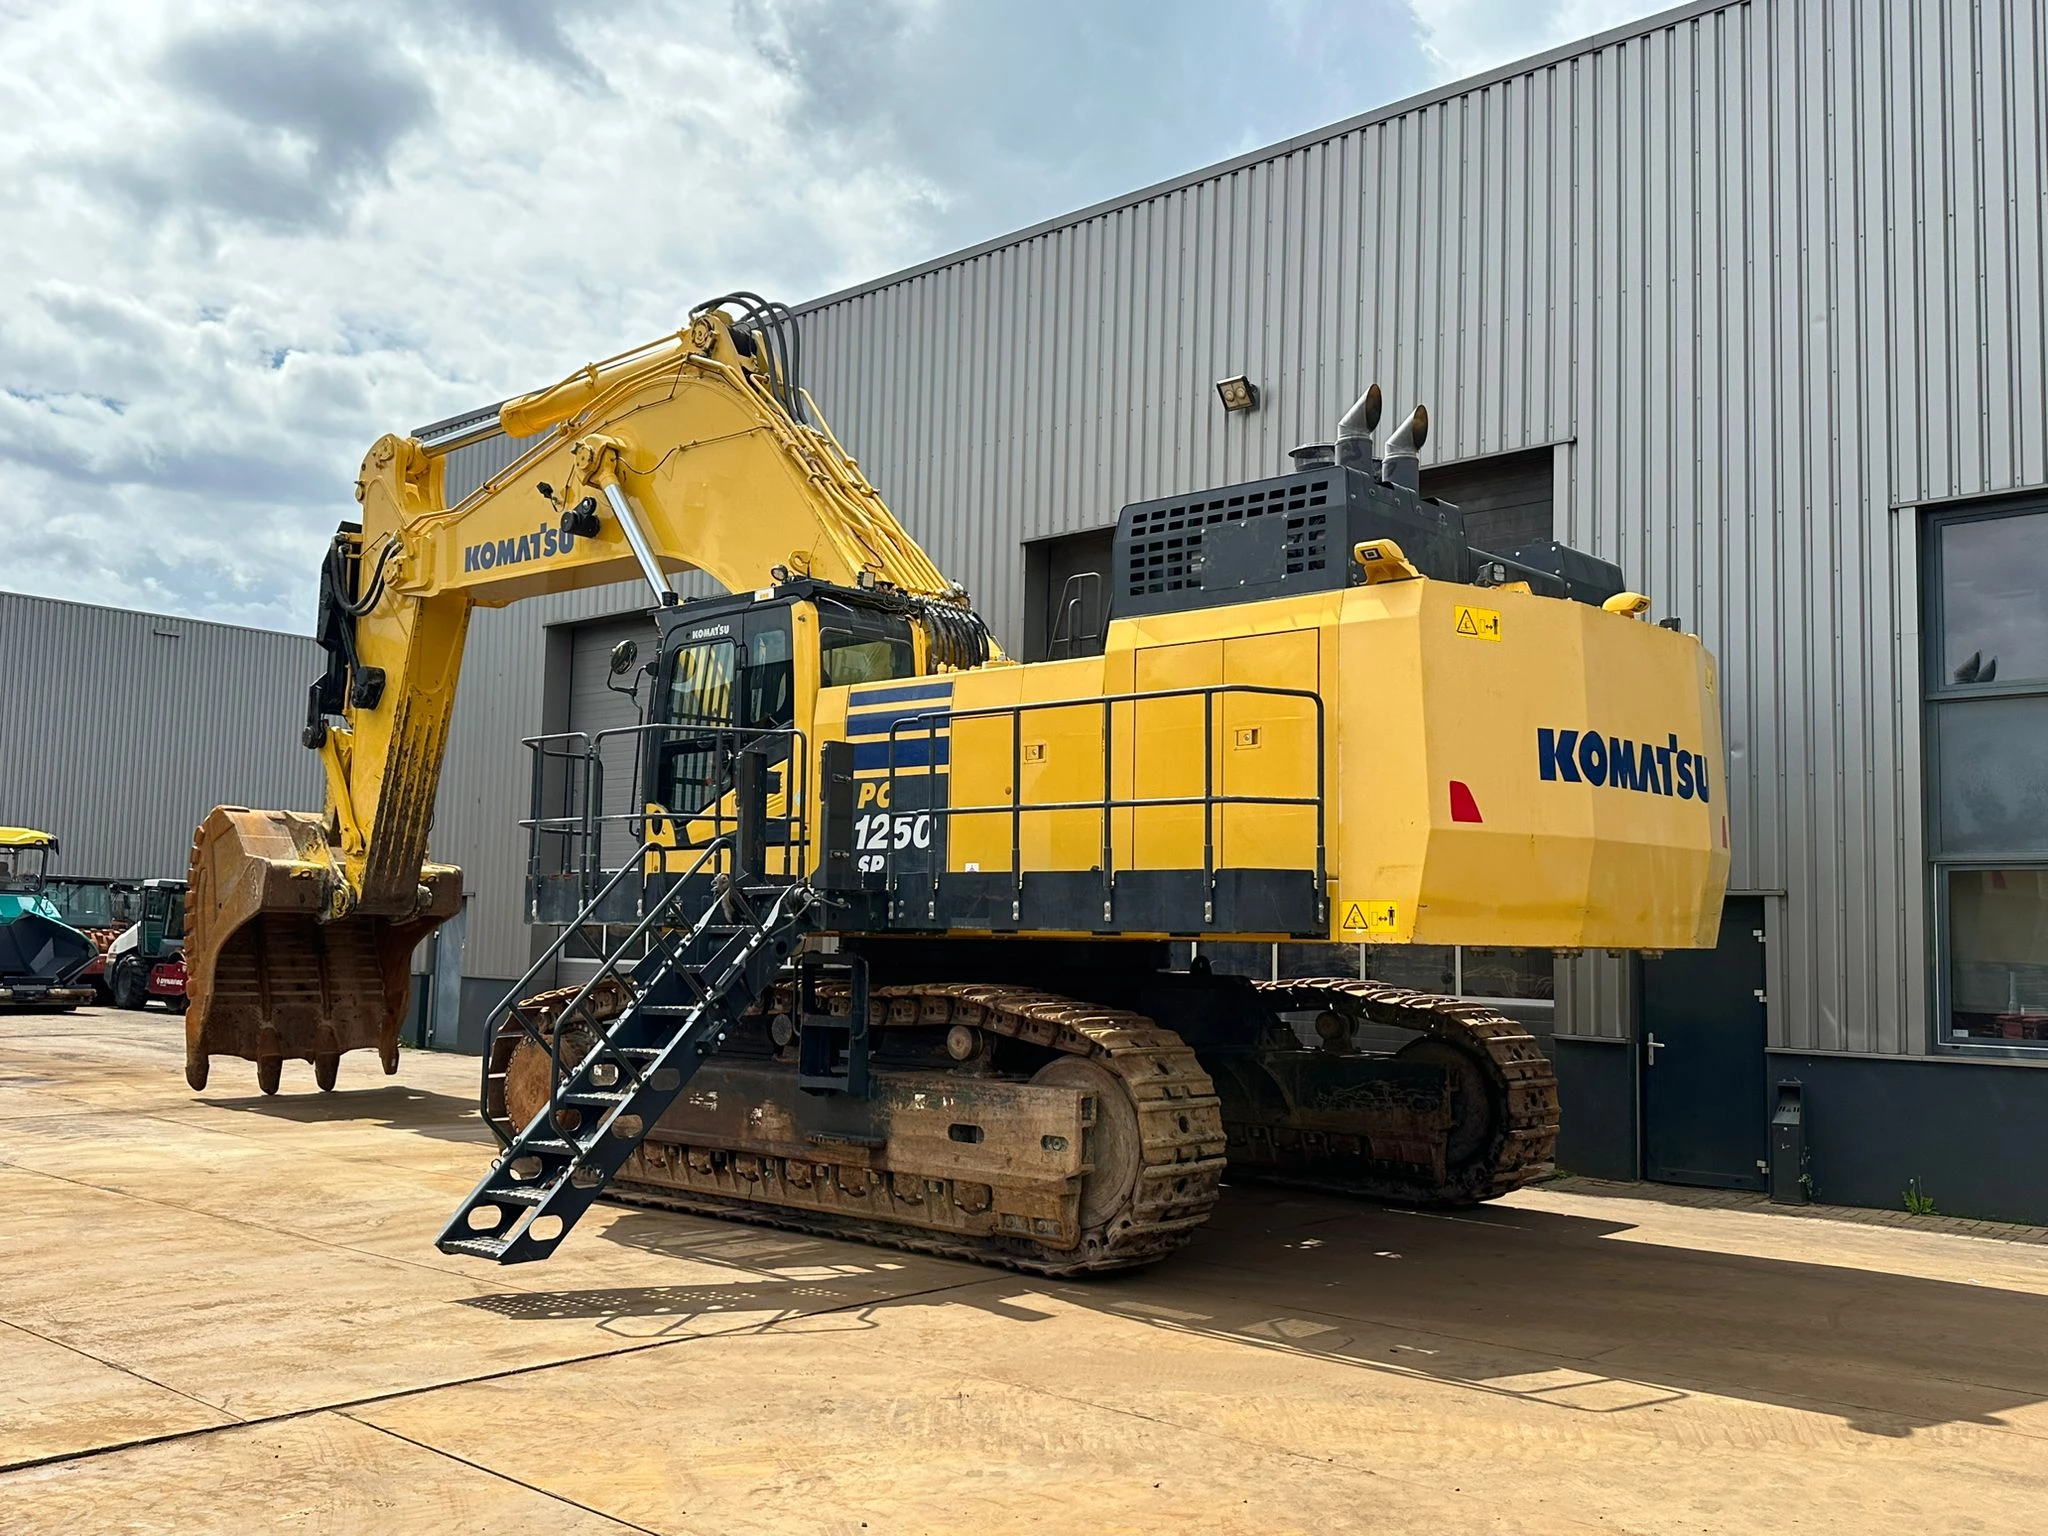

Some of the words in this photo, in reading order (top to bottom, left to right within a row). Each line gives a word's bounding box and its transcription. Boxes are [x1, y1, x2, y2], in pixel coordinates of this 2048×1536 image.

[464, 522, 574, 573] KOMATSU
[692, 624, 730, 639] KOMATSU
[1537, 727, 1709, 803] KOMATSU
[857, 781, 890, 809] PC
[854, 813, 937, 850] 1250
[857, 854, 885, 873] SP
